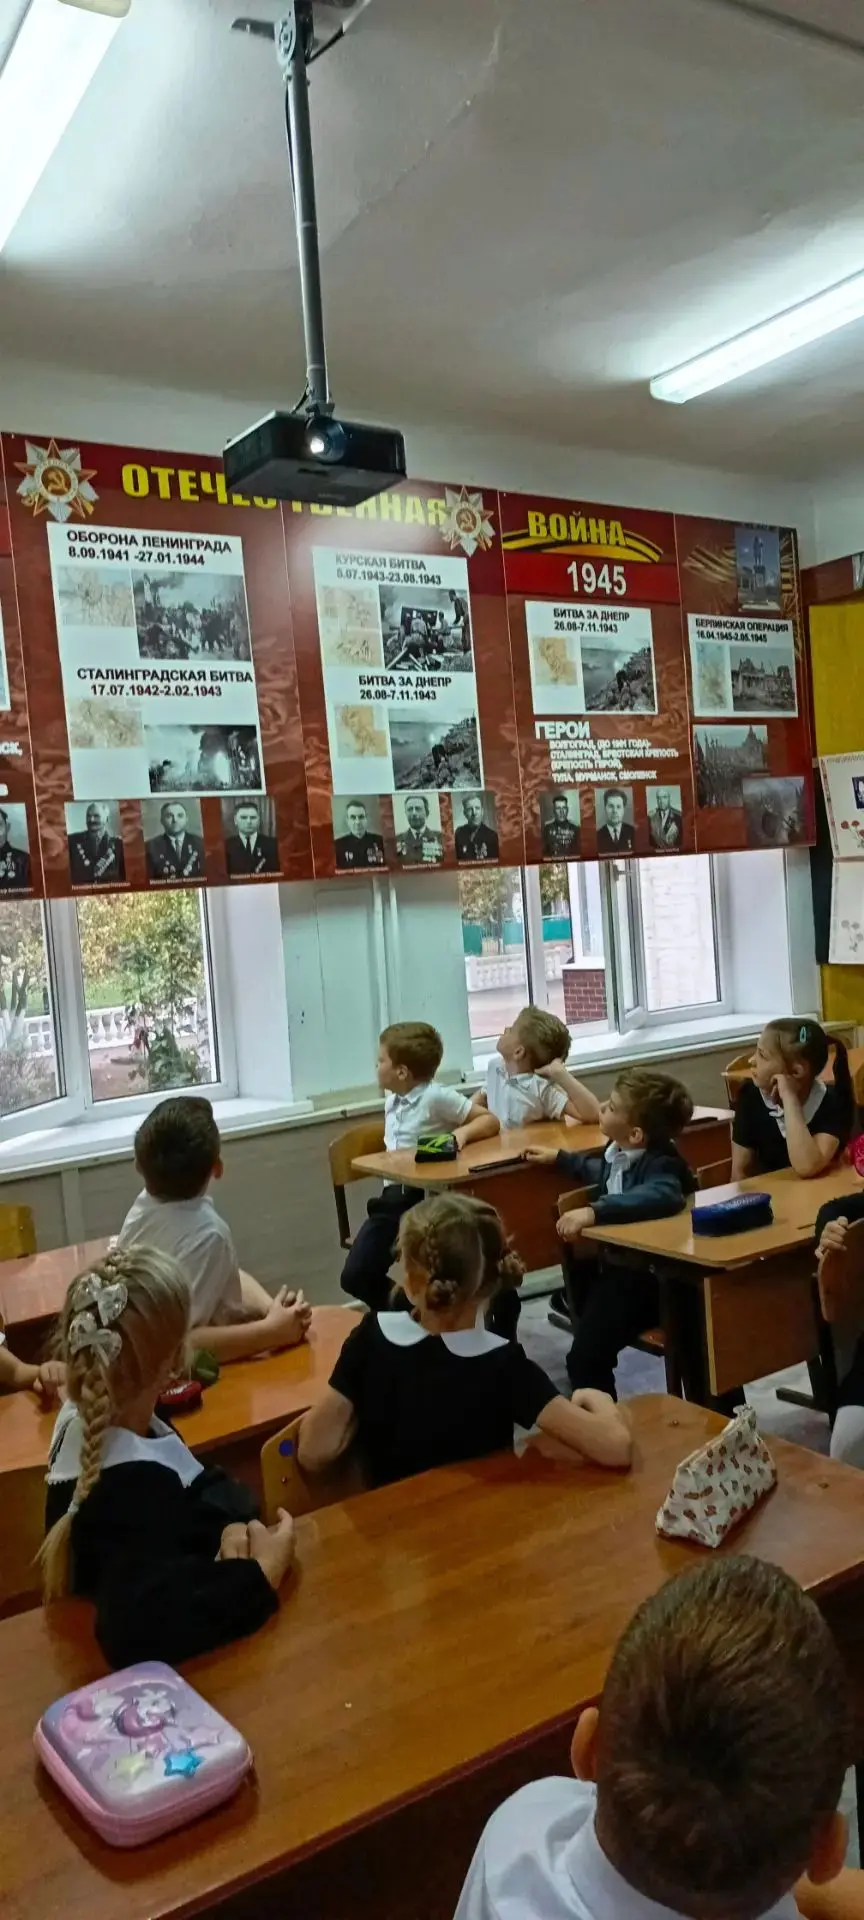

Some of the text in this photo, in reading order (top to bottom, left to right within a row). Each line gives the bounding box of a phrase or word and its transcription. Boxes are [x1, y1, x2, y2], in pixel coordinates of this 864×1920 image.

[121, 463, 447, 526] ОТЕЧННАЯ
[528, 510, 626, 547] ВОЙНА
[67, 530, 232, 554] ОБОРОНА ЛЕНИНГРАДА
[68, 546, 205, 565] 8.09.1941 -27.01.1944
[336, 553, 427, 571] КУРСКАЯ БИТВА
[567, 561, 627, 595] 1945
[553, 608, 630, 622] БИТВА ЗА ДНЕПР
[696, 618, 789, 634] БЕРЛИНСКАЯ ОПЕРАЦИЯ
[77, 668, 253, 683] СТАЛИНГРАДСКАЯ БИТВА
[359, 674, 452, 688] БИТВА ЗА ДНЕПР
[91, 684, 222, 697] 17.07.1942-2.02.1943
[360, 689, 437, 700] 26.08-7.11.1943
[535, 720, 590, 739] ГЕРОИ
